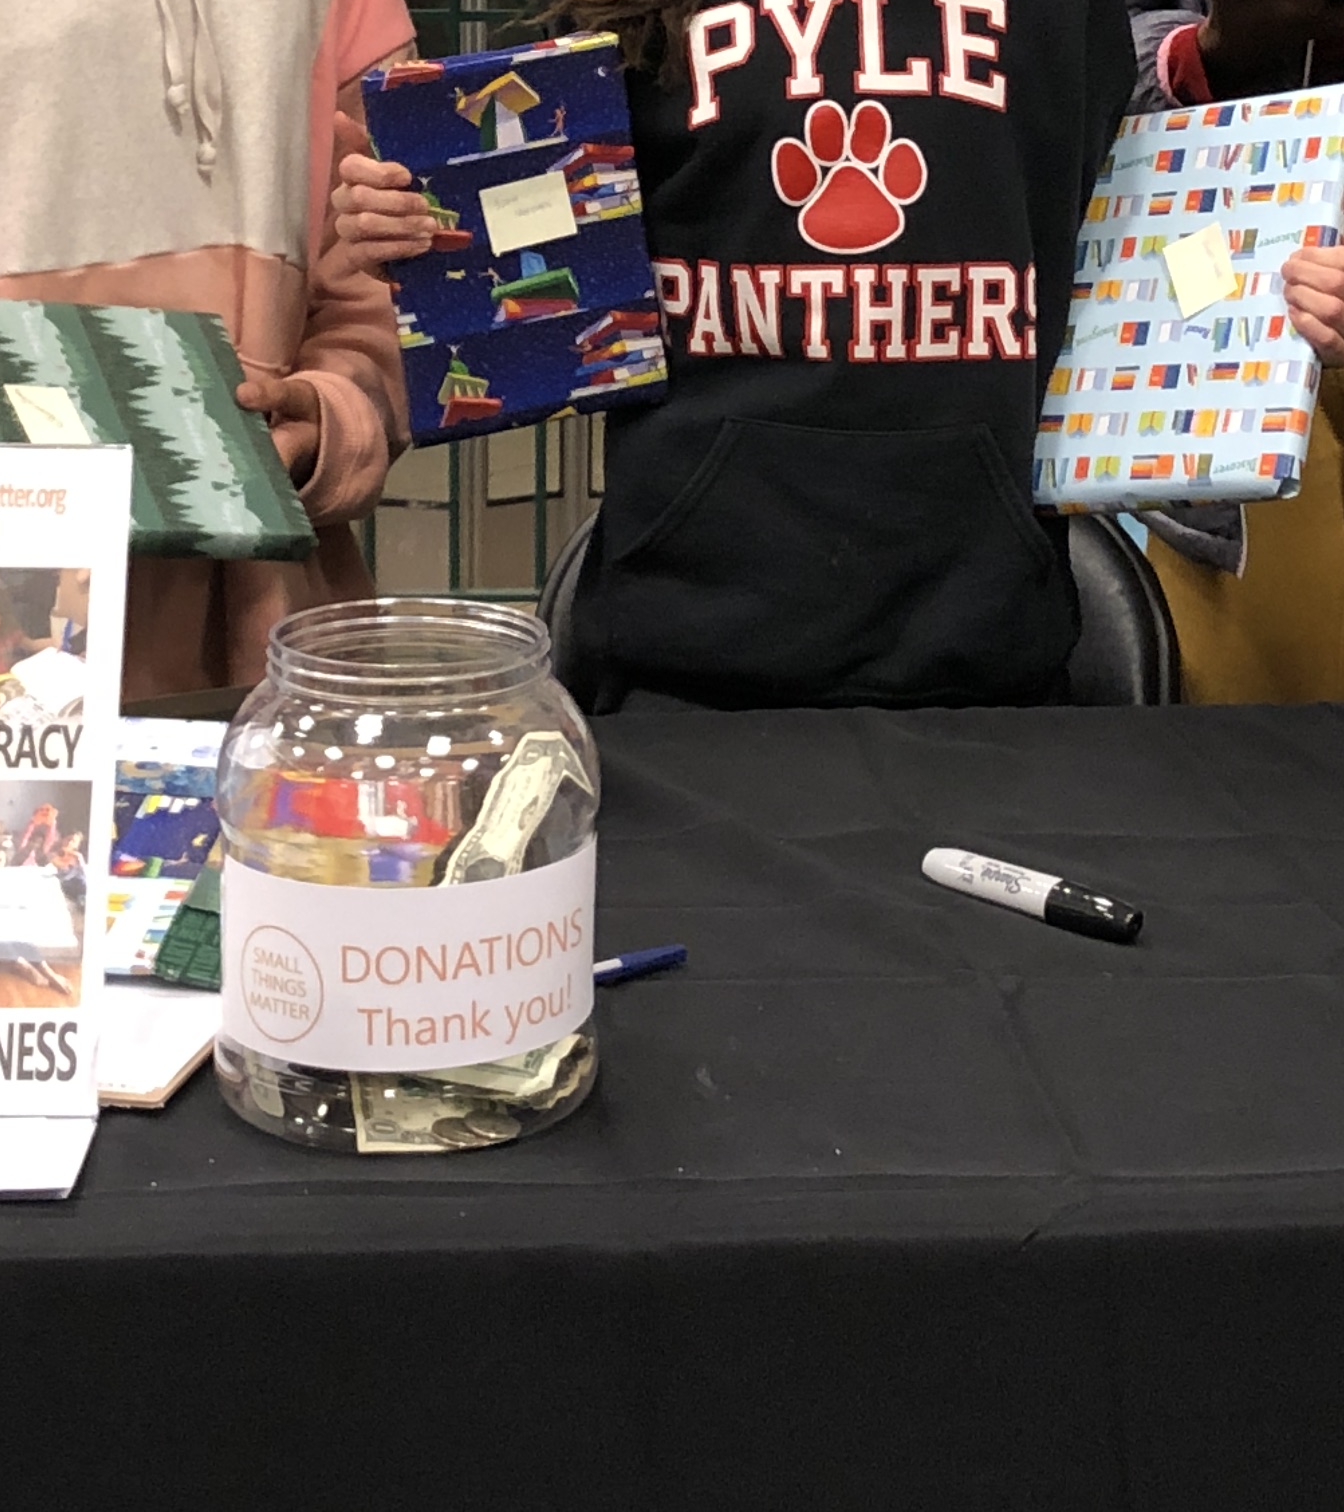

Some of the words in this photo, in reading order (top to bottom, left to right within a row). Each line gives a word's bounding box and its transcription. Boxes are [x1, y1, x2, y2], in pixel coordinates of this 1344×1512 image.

[252, 946, 304, 976] SMALL
[340, 908, 584, 985] DONATIONS
[250, 970, 308, 999] THINGS
[249, 992, 311, 1023] MATTER
[357, 1000, 492, 1047] Thank
[505, 986, 573, 1045] you!
